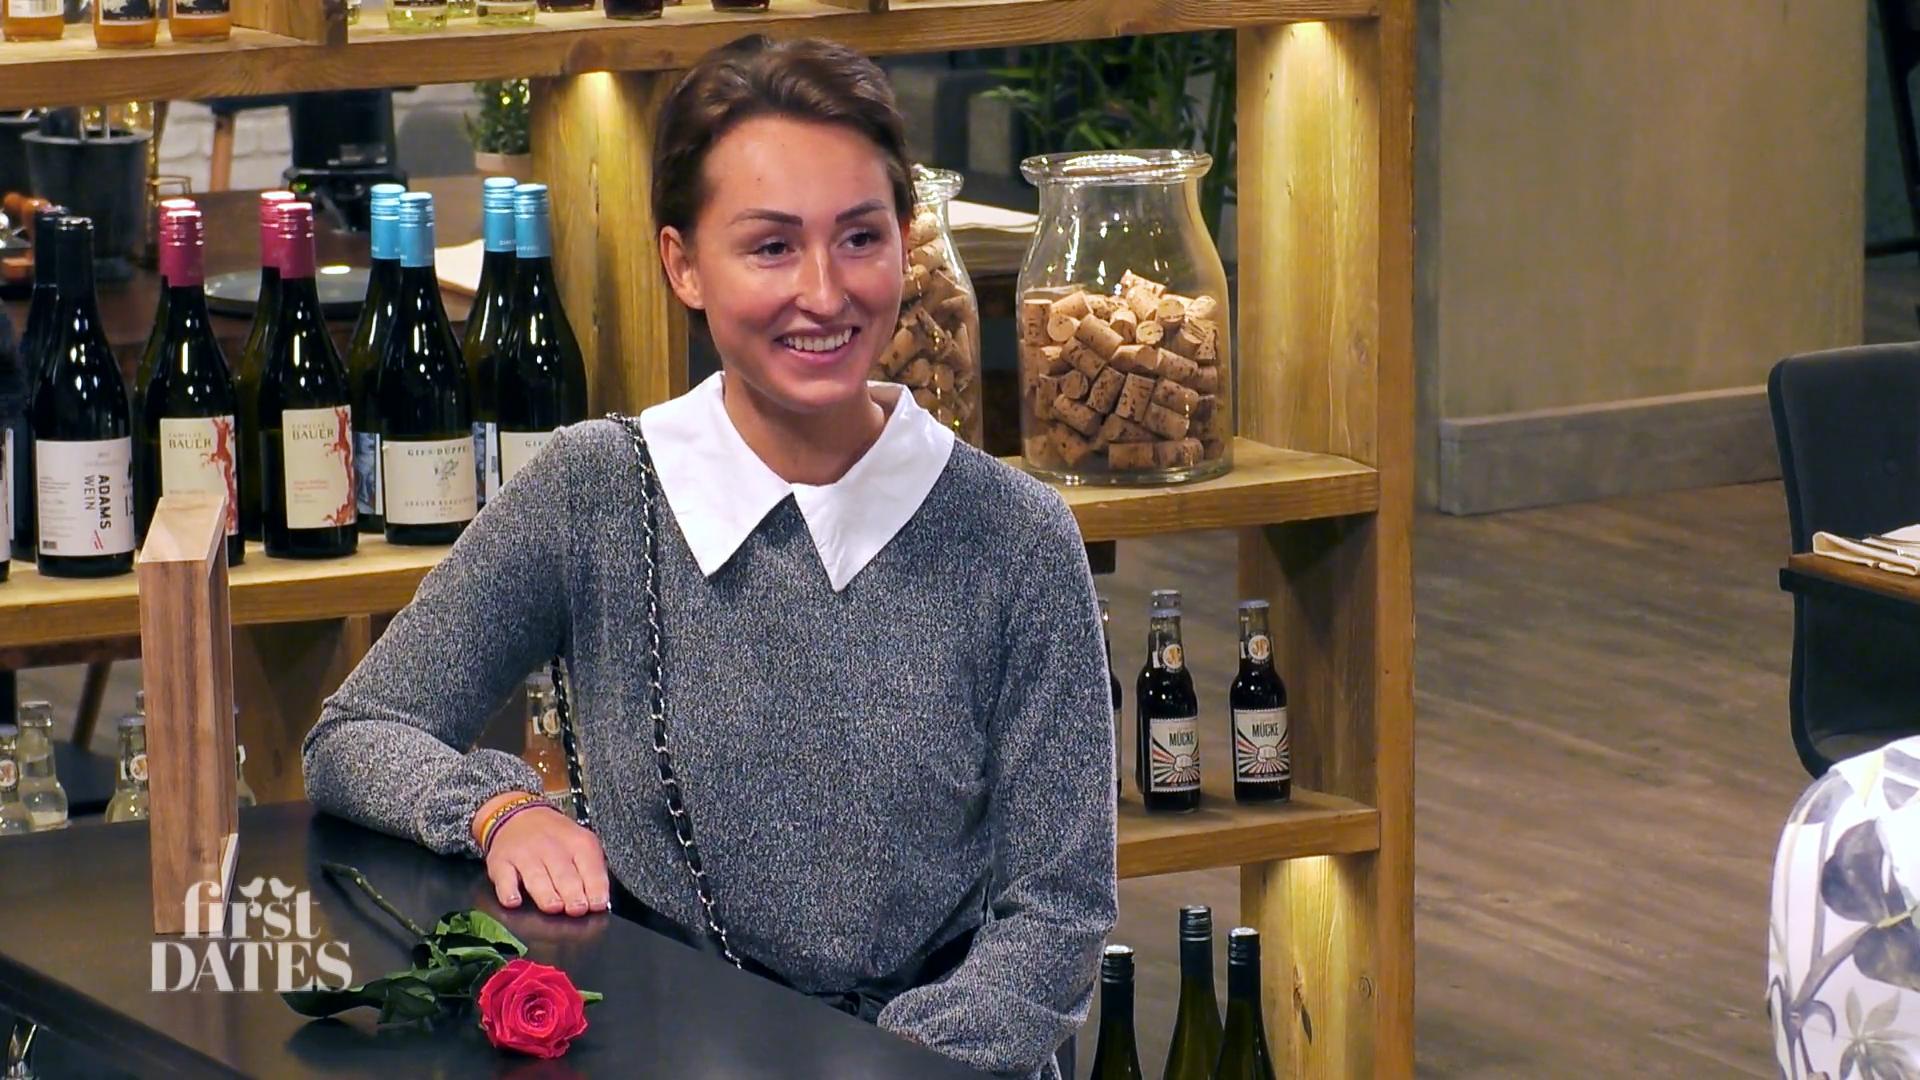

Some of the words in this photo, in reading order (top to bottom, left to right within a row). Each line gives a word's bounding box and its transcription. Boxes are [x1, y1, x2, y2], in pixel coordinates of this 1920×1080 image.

[292, 428, 334, 441] BAUER
[169, 438, 212, 449] BAUER
[84, 475, 96, 511] WEIN
[98, 474, 112, 530] ADAMS
[1169, 729, 1194, 747] MÜCKE
[1252, 721, 1279, 738] MÜCKE
